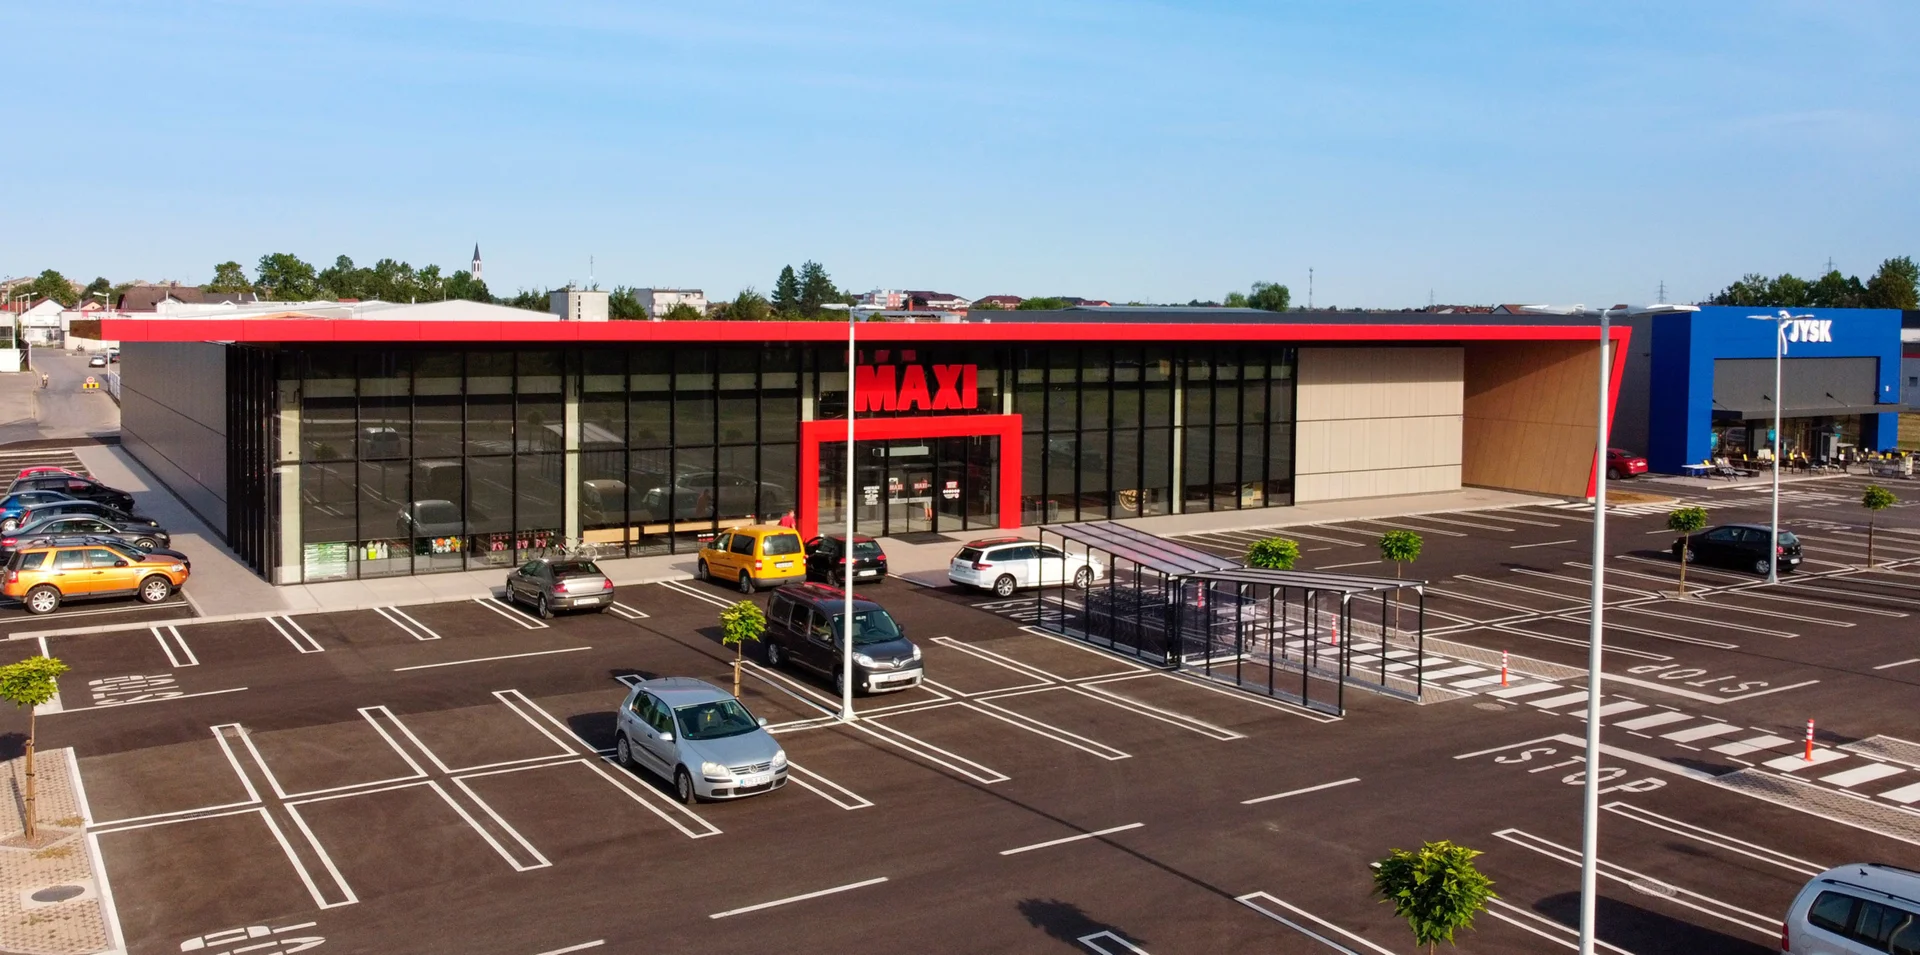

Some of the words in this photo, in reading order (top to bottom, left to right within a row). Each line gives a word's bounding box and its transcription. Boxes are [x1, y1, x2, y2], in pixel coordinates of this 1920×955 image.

[1789, 319, 1832, 342] JYSK
[854, 364, 978, 412] MAXI
[1626, 663, 1769, 693] STOP
[1494, 746, 1668, 796] STOP
